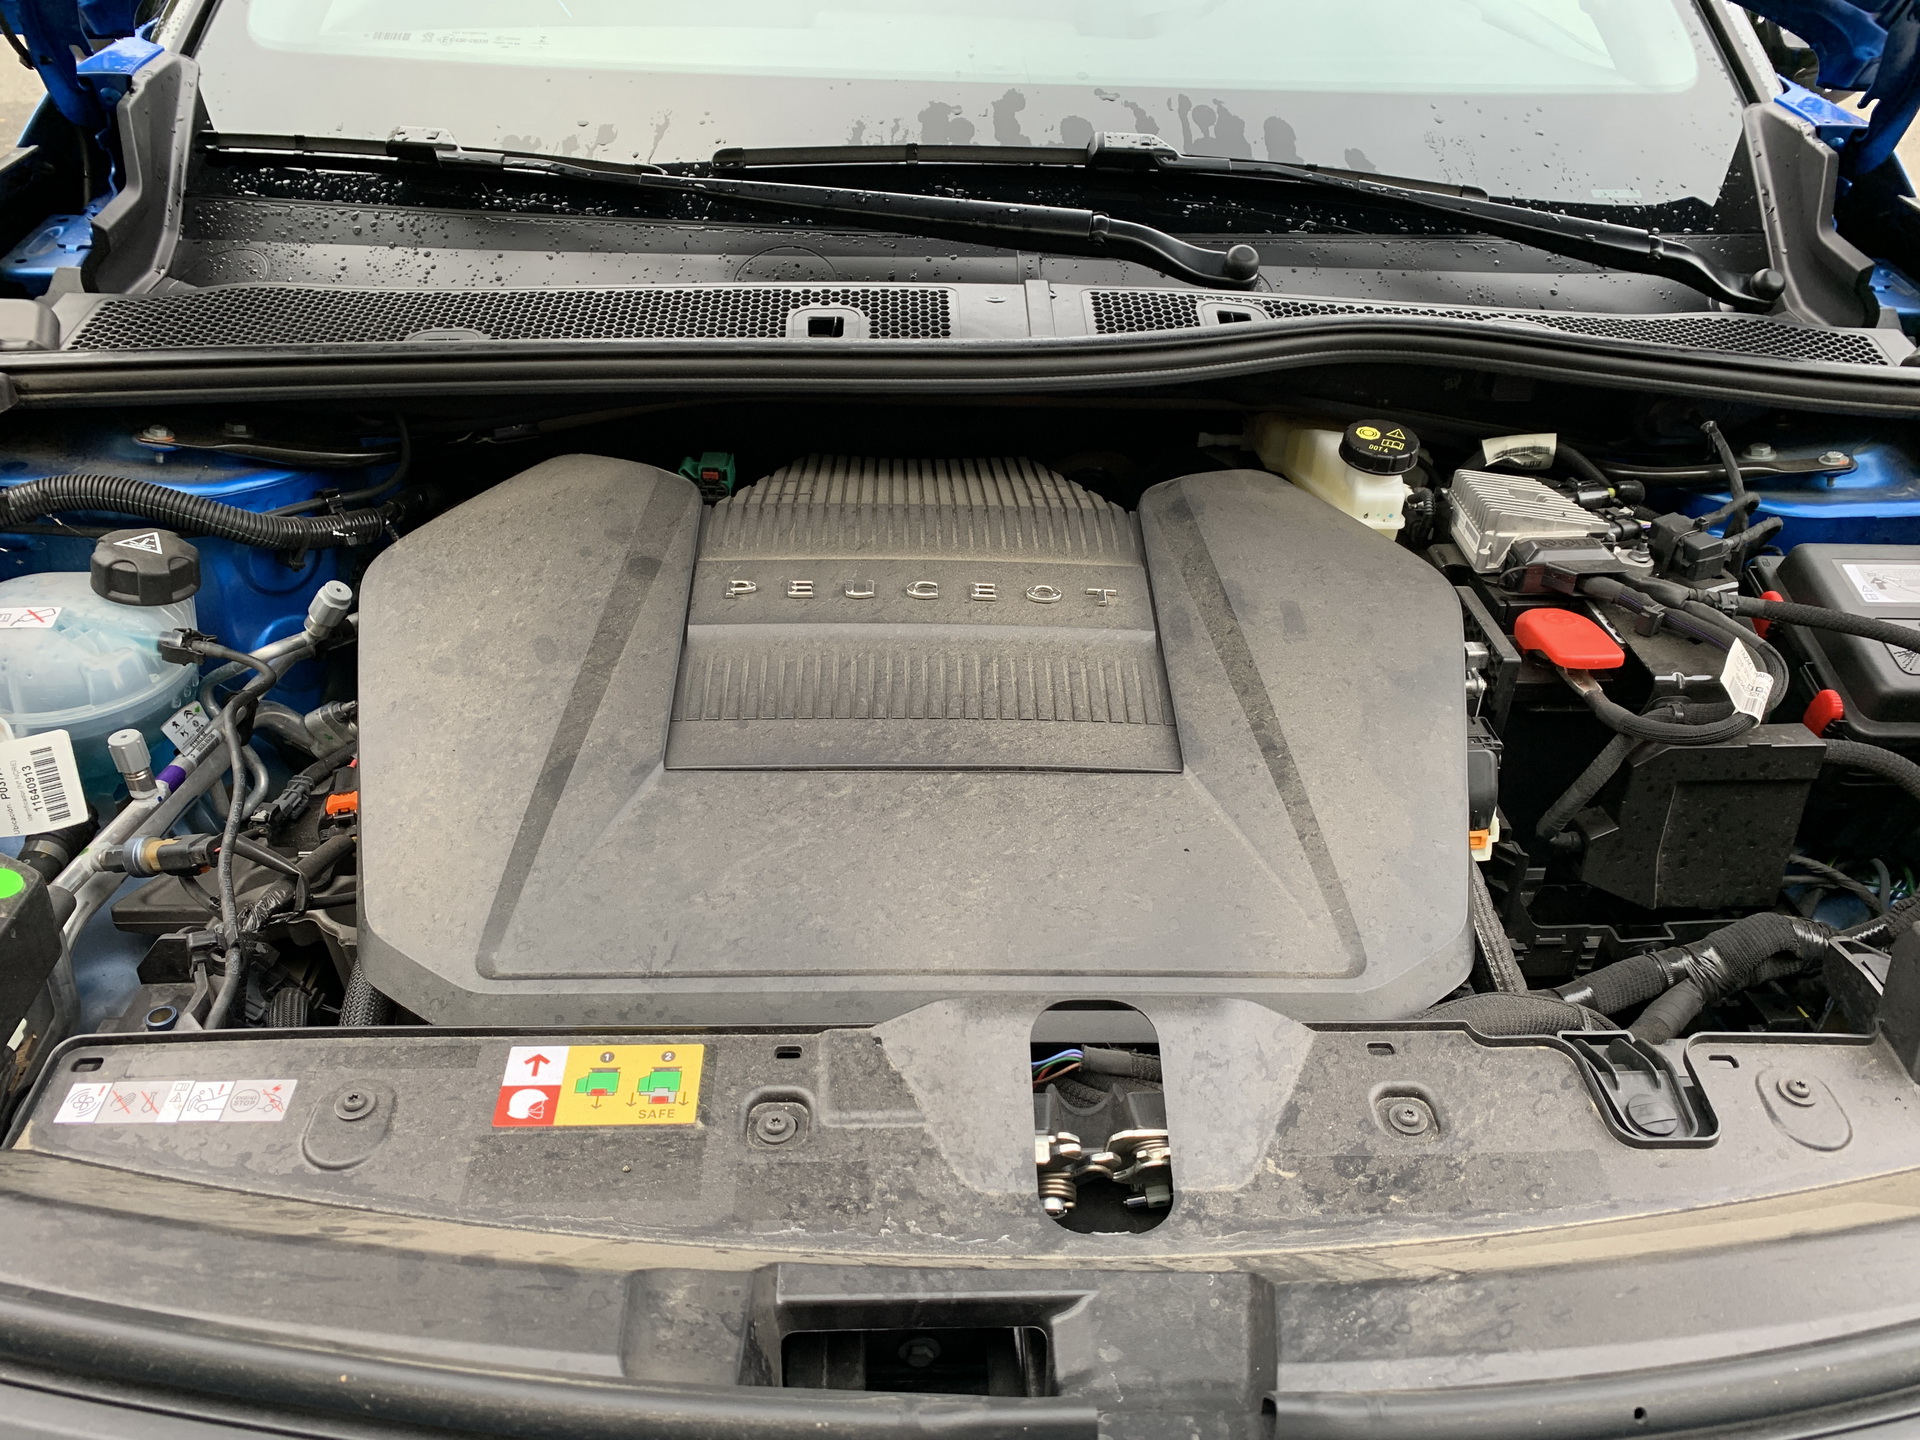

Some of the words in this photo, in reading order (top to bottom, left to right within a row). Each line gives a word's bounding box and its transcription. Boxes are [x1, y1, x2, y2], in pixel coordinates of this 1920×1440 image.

[1368, 444, 1382, 452] DOT
[724, 579, 1117, 606] PEUGEOT
[21, 765, 43, 812] 11640913
[604, 1053, 610, 1061] 1
[664, 1052, 672, 1061] 2
[638, 1109, 675, 1119] SAFE
